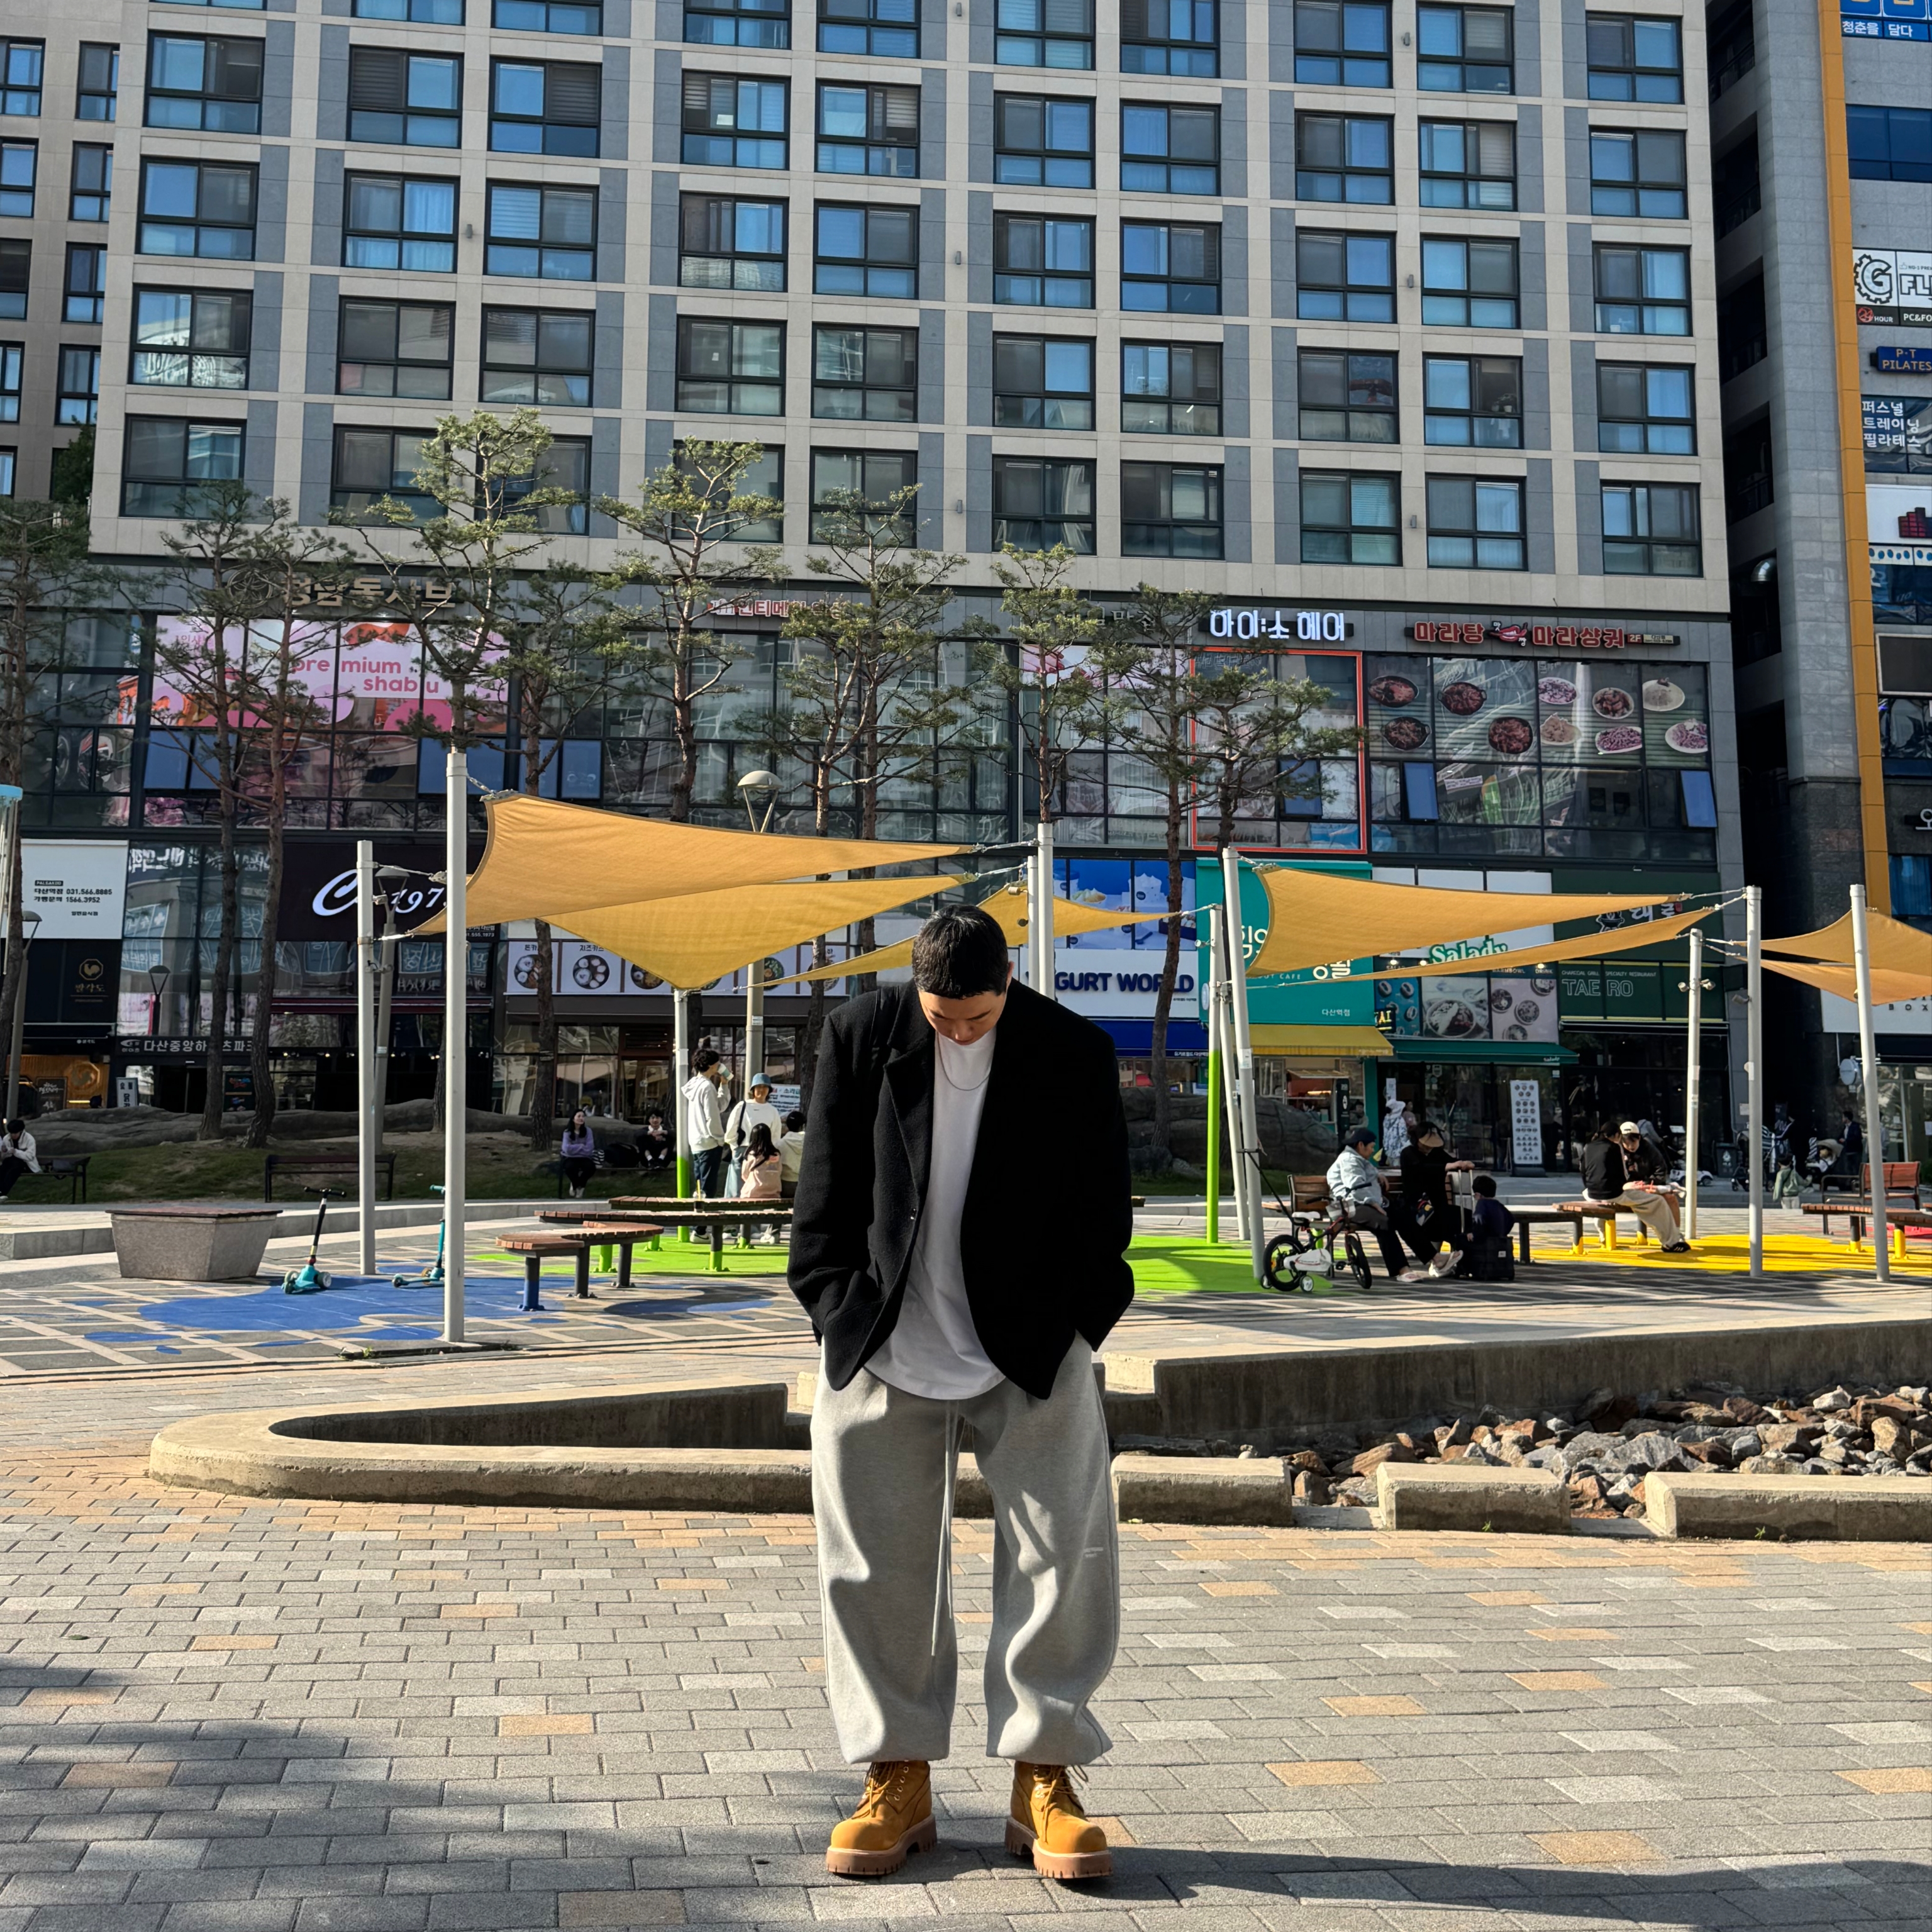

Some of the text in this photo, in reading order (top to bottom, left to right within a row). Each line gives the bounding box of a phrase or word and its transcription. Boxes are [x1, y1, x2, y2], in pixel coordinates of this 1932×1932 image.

[1842, 21, 1913, 38] 청춘을 담다
[1882, 360, 1931, 371] PILATES
[1862, 401, 1903, 416] 퍼스널
[1863, 417, 1919, 433] 트레이닝
[1863, 433, 1921, 448] 필라테스
[1297, 611, 1345, 641] 헤어
[1414, 621, 1485, 644] 마라탕
[1532, 625, 1625, 648] 마라샹궈
[1629, 634, 1641, 642] 2F
[1562, 979, 1634, 997] TAE RO
[1321, 1009, 1350, 1017] 다산역점
[143, 1040, 252, 1053] 다산중앙하츠파
